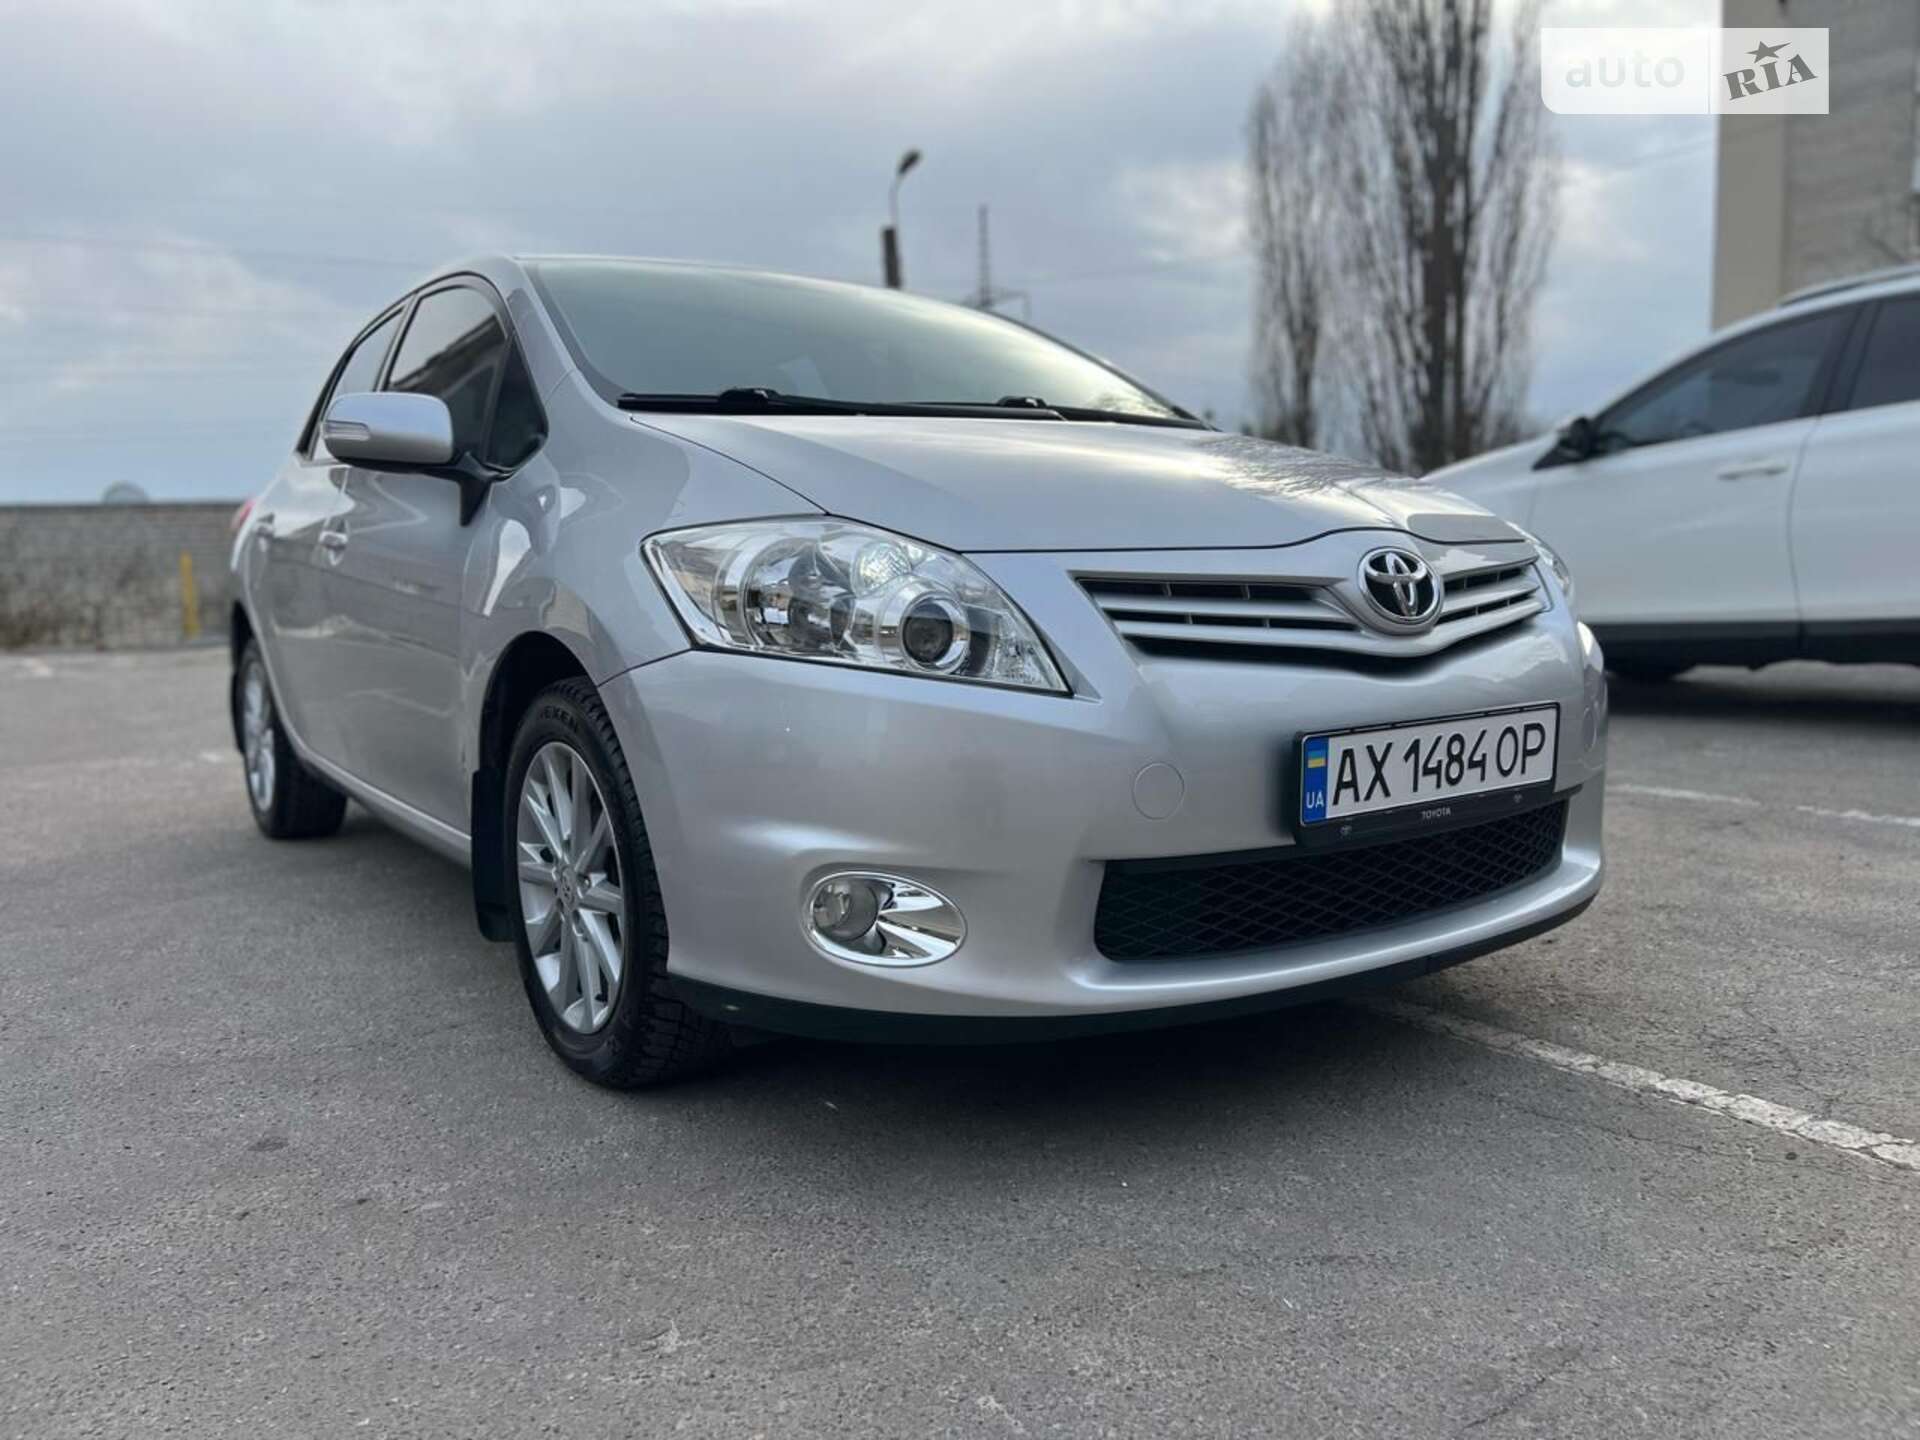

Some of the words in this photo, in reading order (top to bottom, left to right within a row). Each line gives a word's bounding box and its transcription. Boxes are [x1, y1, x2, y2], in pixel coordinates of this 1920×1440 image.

[539, 705, 579, 733] EXEN
[1332, 742, 1393, 806] AX
[1403, 730, 1488, 793] 1484
[1496, 722, 1546, 778] OP
[1306, 790, 1325, 810] UA
[1421, 806, 1452, 820] TOYOTA
